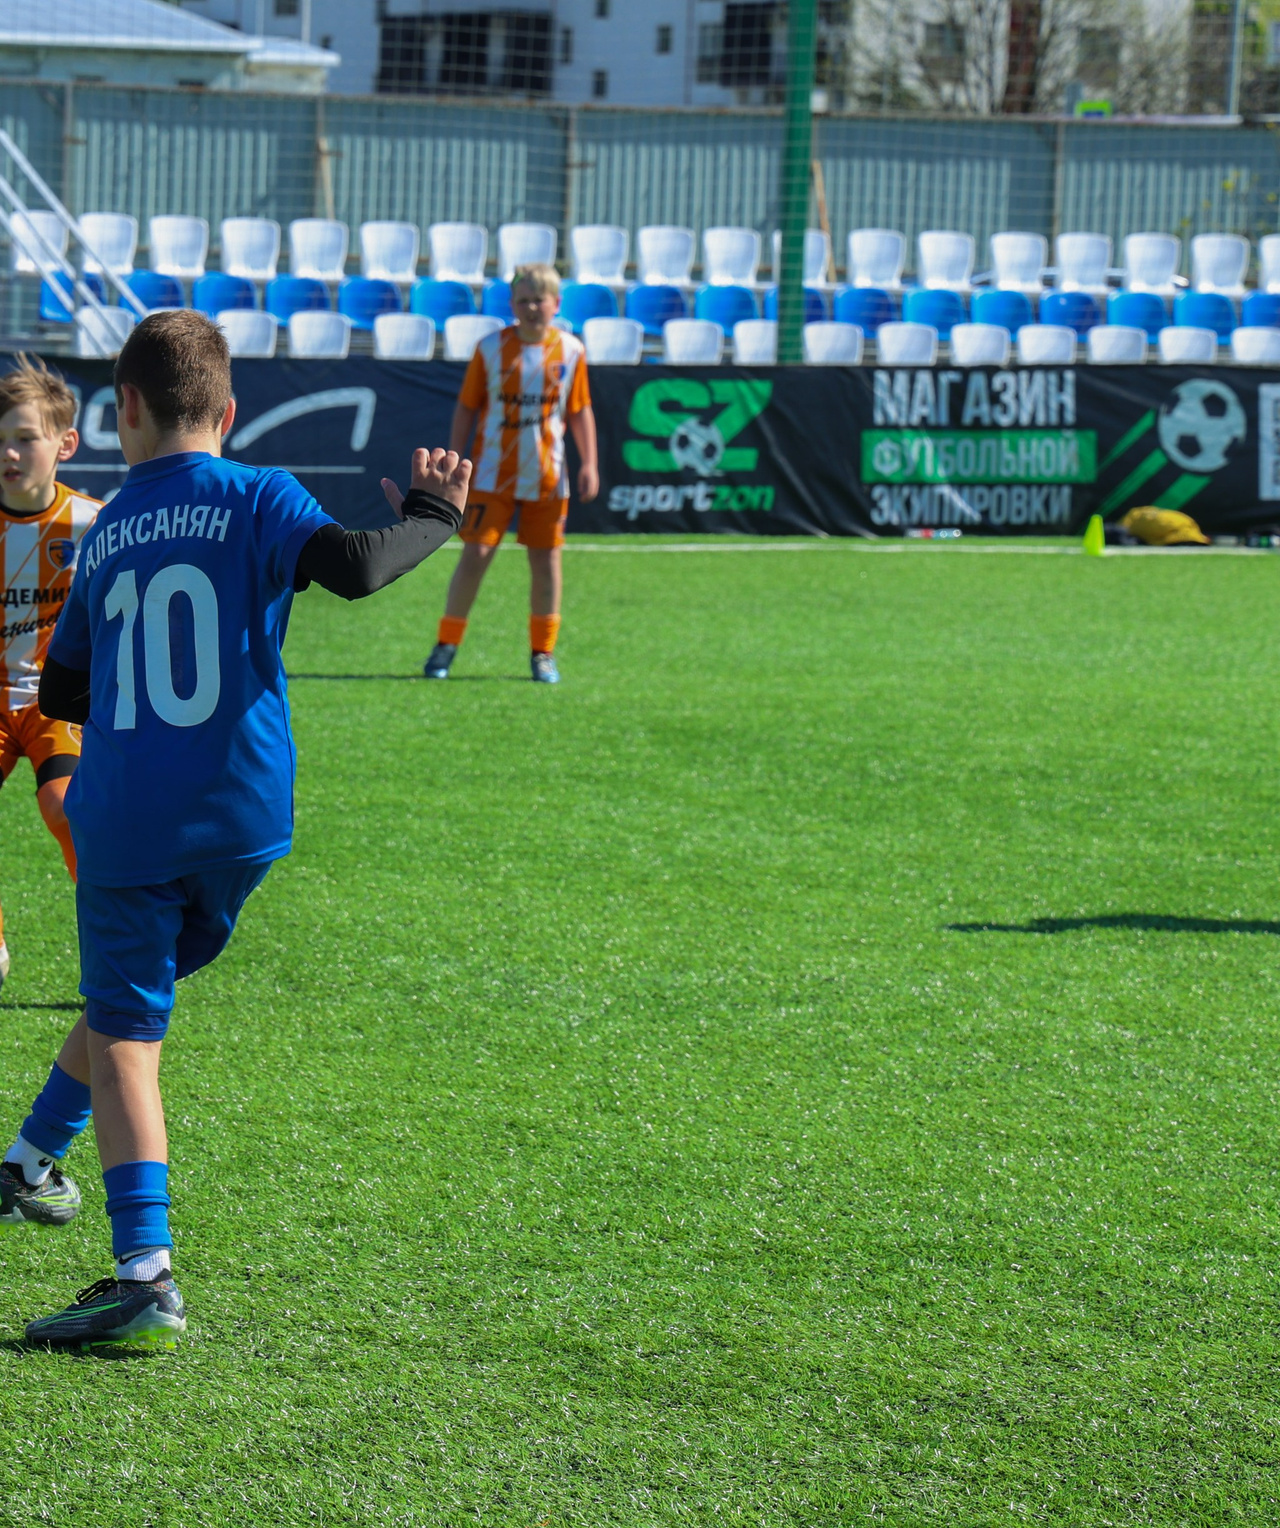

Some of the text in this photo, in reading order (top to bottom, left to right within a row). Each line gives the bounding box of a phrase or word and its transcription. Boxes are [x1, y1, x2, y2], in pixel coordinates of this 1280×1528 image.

[872, 369, 1077, 427] МАГАЗИН
[871, 429, 1081, 478] ФУТБОЛЬНОЙ
[607, 480, 775, 521] sportzon
[870, 483, 1073, 525] ЭКИПИРОВКИ
[85, 504, 232, 578] АЛЕКСАНЯН
[104, 563, 220, 730] 10
